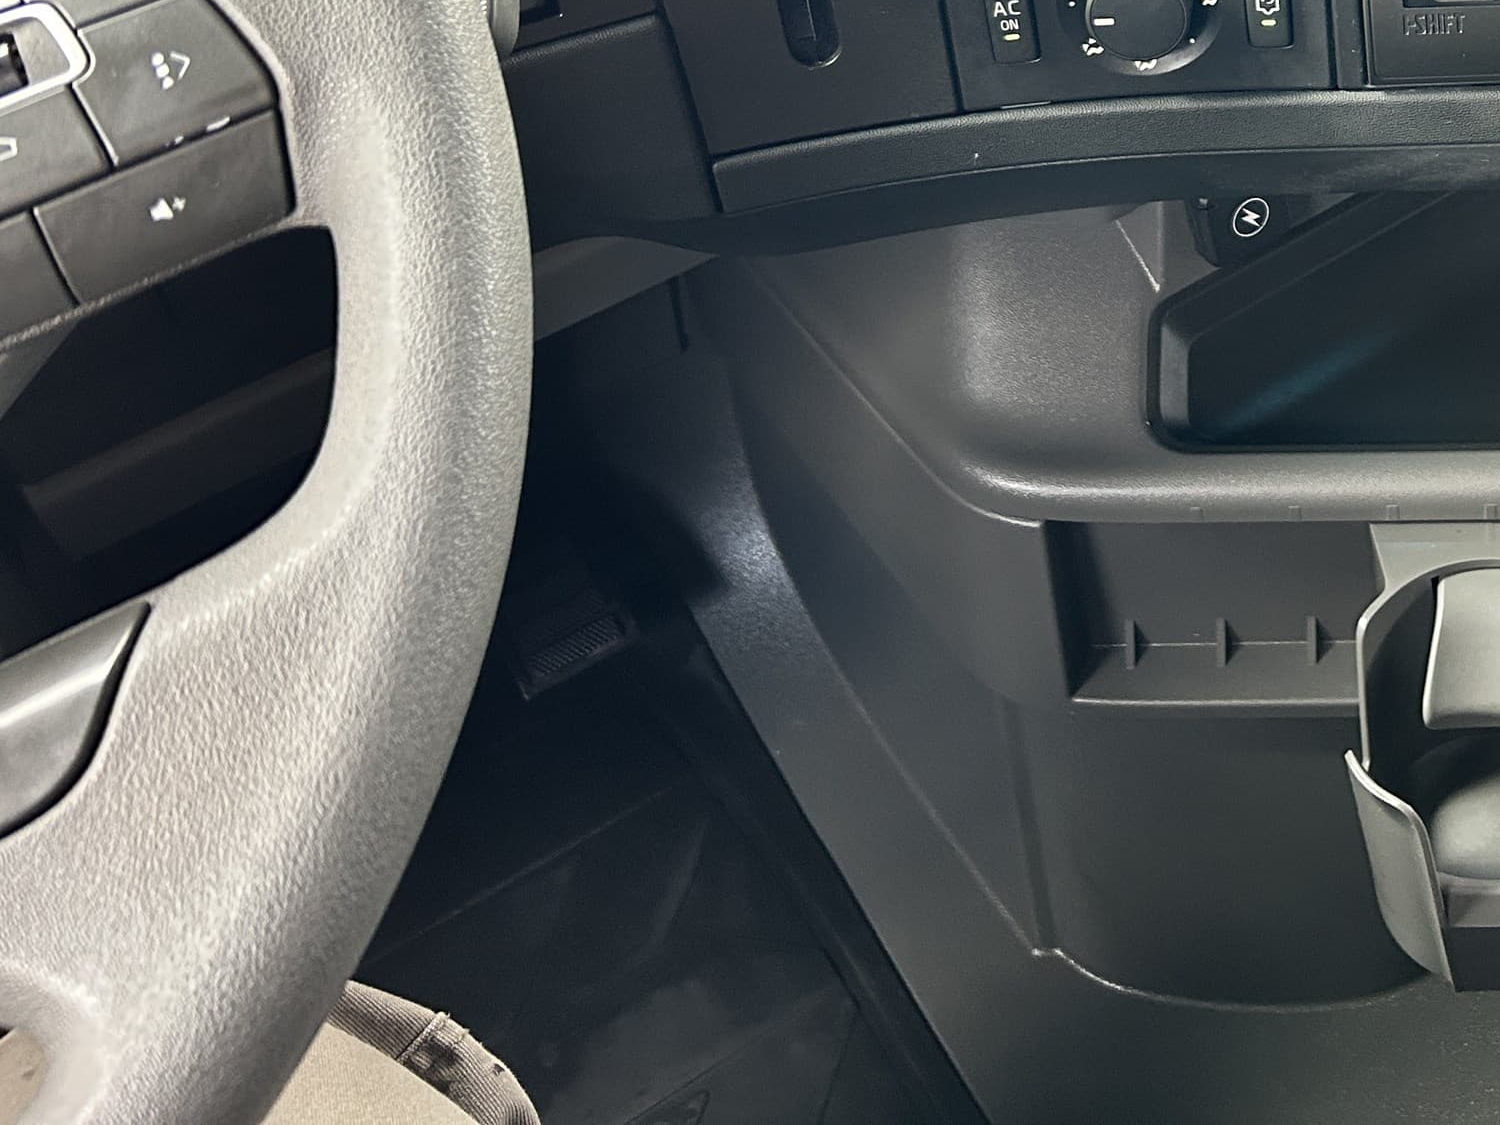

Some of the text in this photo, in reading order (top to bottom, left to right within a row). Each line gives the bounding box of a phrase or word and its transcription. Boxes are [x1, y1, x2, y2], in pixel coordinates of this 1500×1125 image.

[993, 0, 1021, 17] AC
[1000, 19, 1019, 31] ON
[1402, 13, 1466, 35] I-SHIFT
